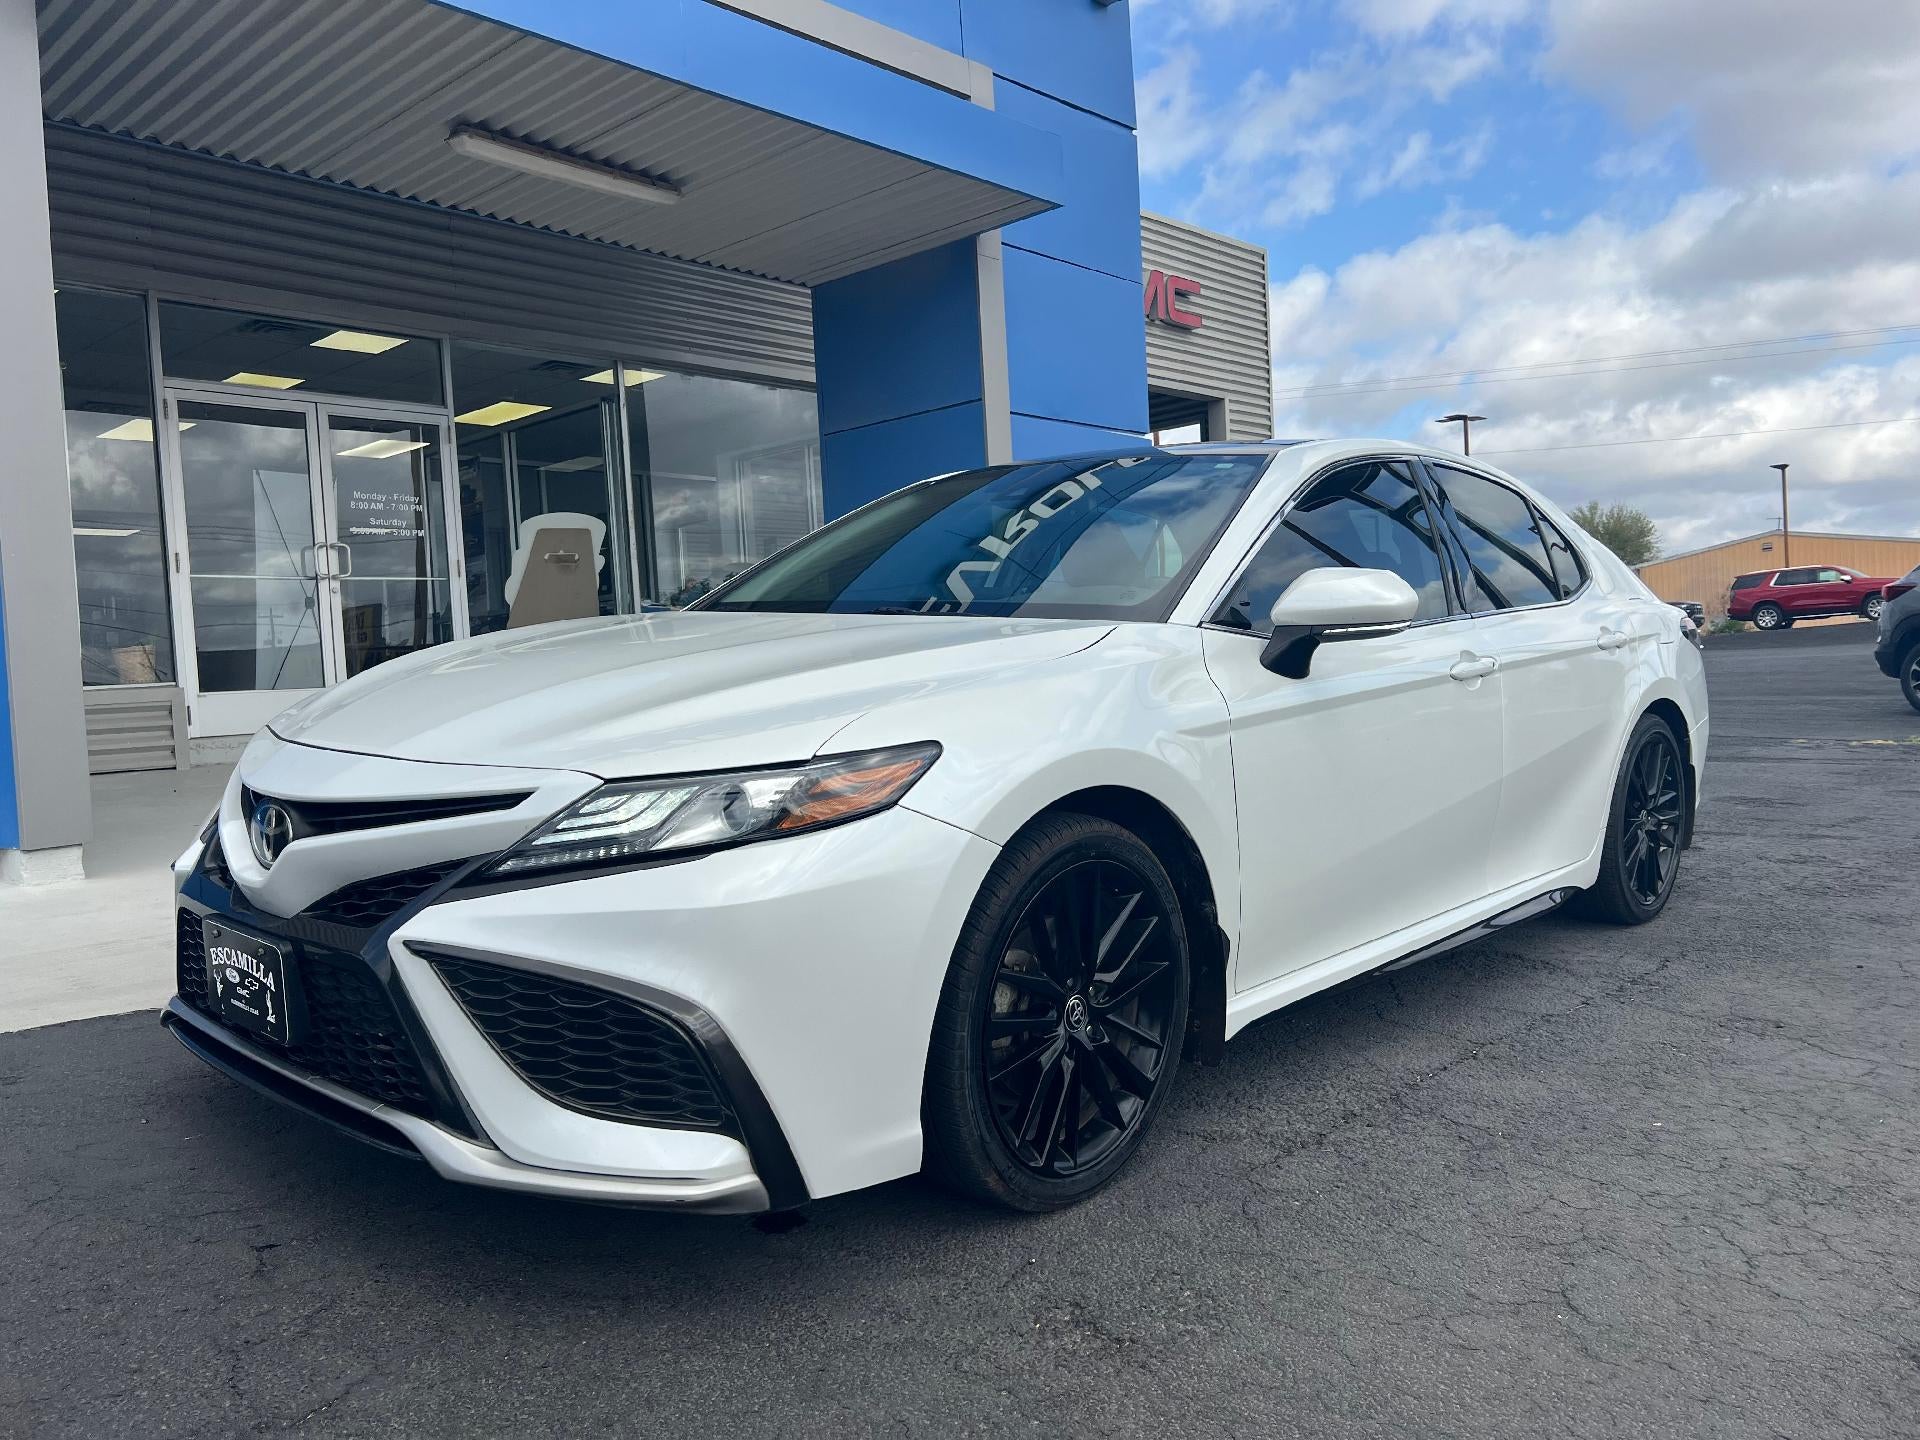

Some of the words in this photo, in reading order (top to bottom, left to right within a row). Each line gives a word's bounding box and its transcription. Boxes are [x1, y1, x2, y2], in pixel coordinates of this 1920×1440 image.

[353, 490, 386, 502] Monday
[394, 493, 420, 504] Friday
[350, 501, 368, 510] 8:00
[370, 502, 384, 511] AM
[391, 503, 409, 511] 7:00
[410, 504, 423, 513] PM
[369, 517, 407, 528] Saturday
[393, 529, 411, 537] 5:00
[412, 529, 425, 537] PM
[210, 947, 275, 992] ESCAMILLA
